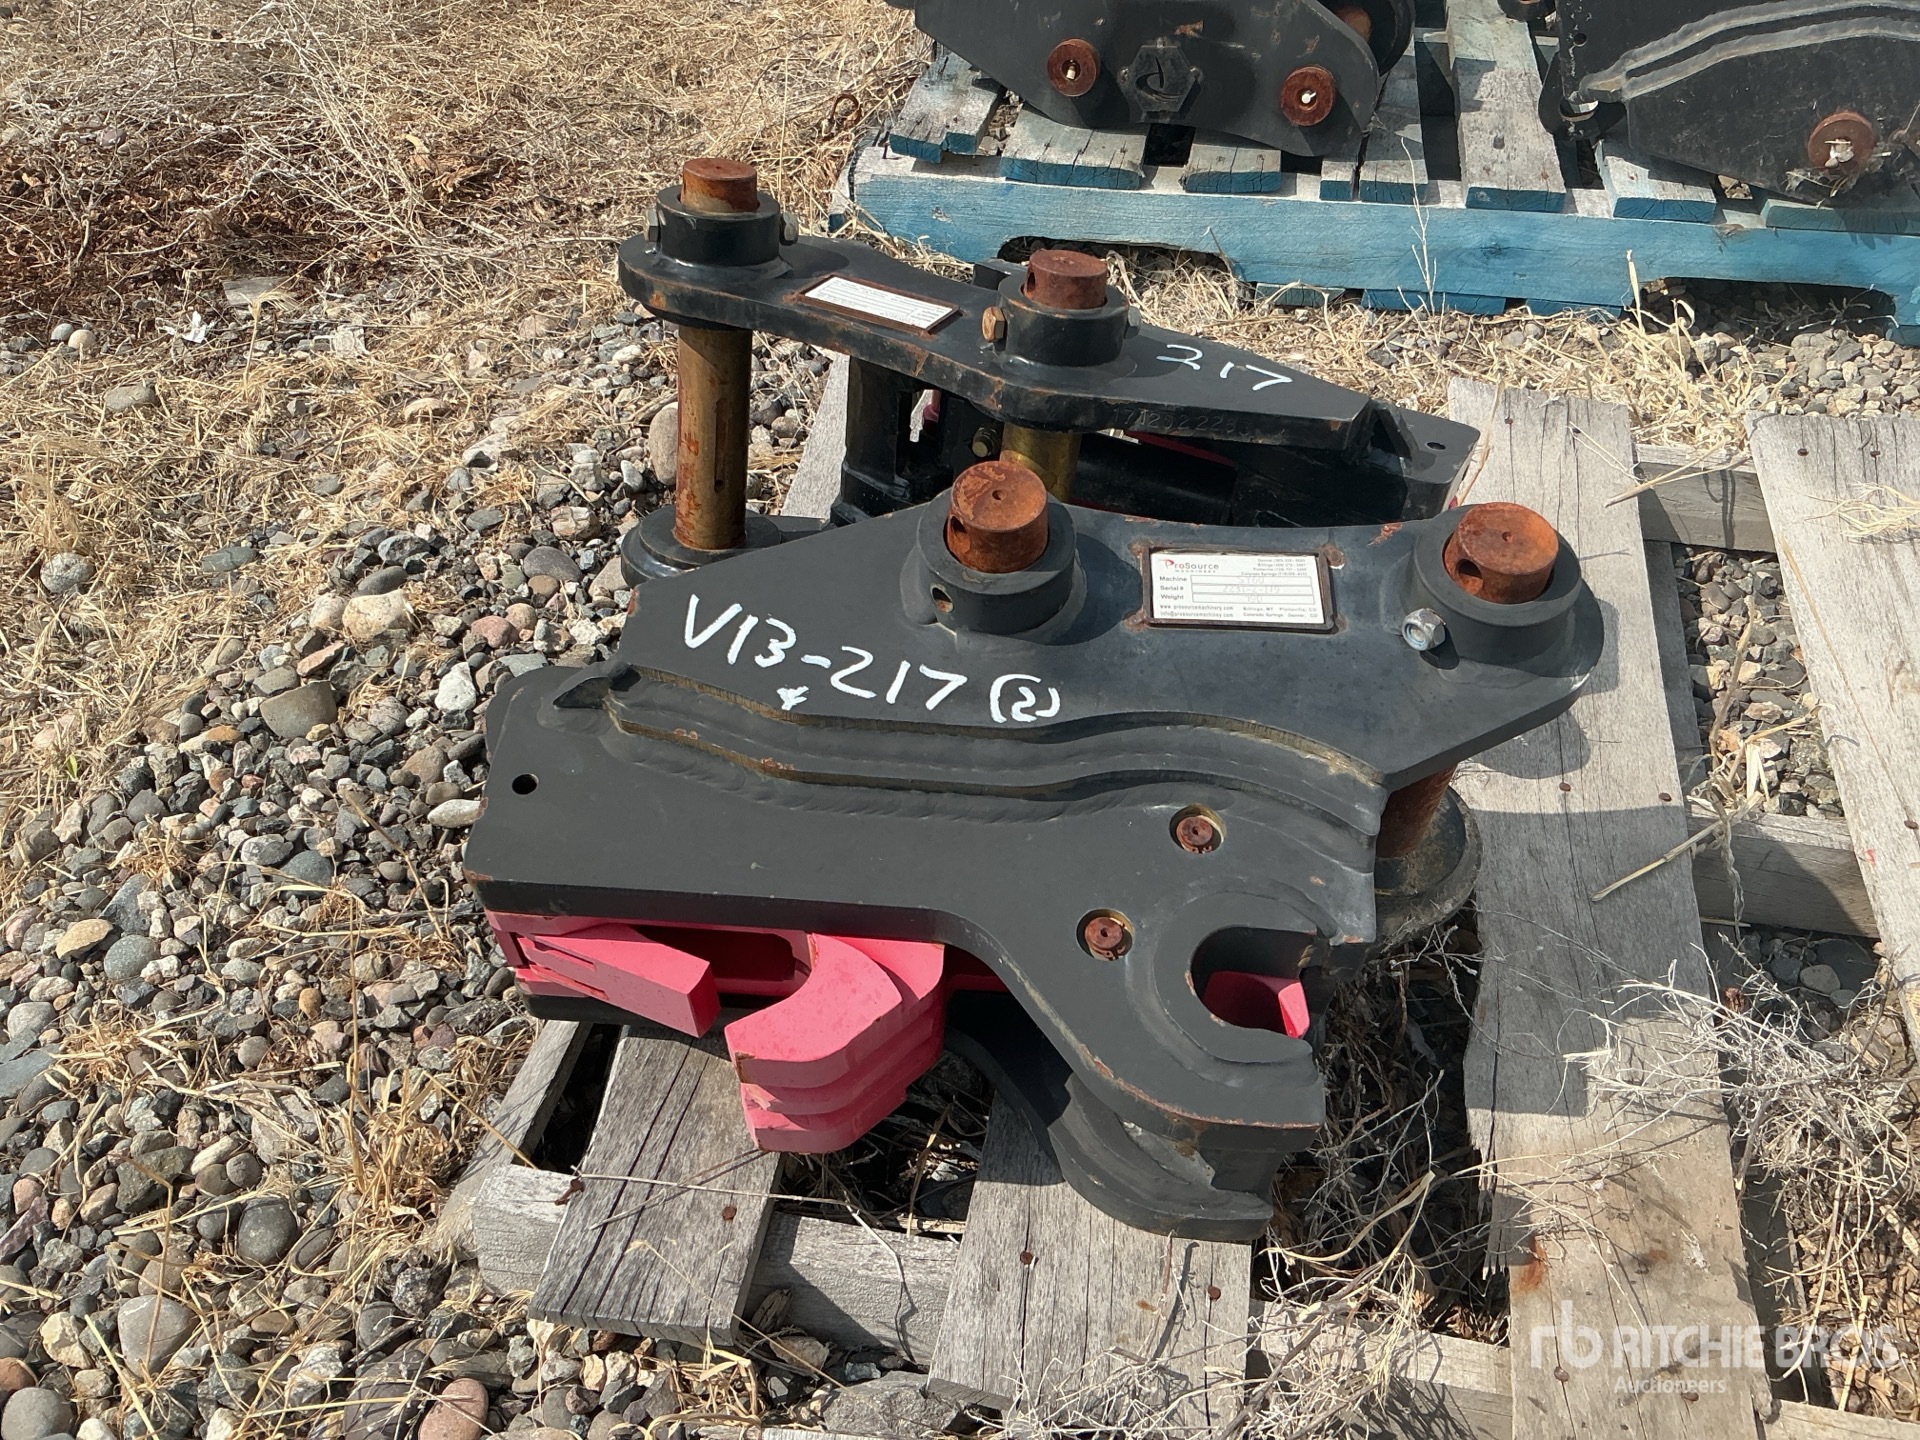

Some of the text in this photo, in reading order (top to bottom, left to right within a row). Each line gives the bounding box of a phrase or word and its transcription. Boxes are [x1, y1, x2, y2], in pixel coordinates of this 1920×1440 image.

[1155, 343, 1294, 392] 217
[1158, 559, 1220, 570] ProSource
[684, 593, 968, 711] V13-217
